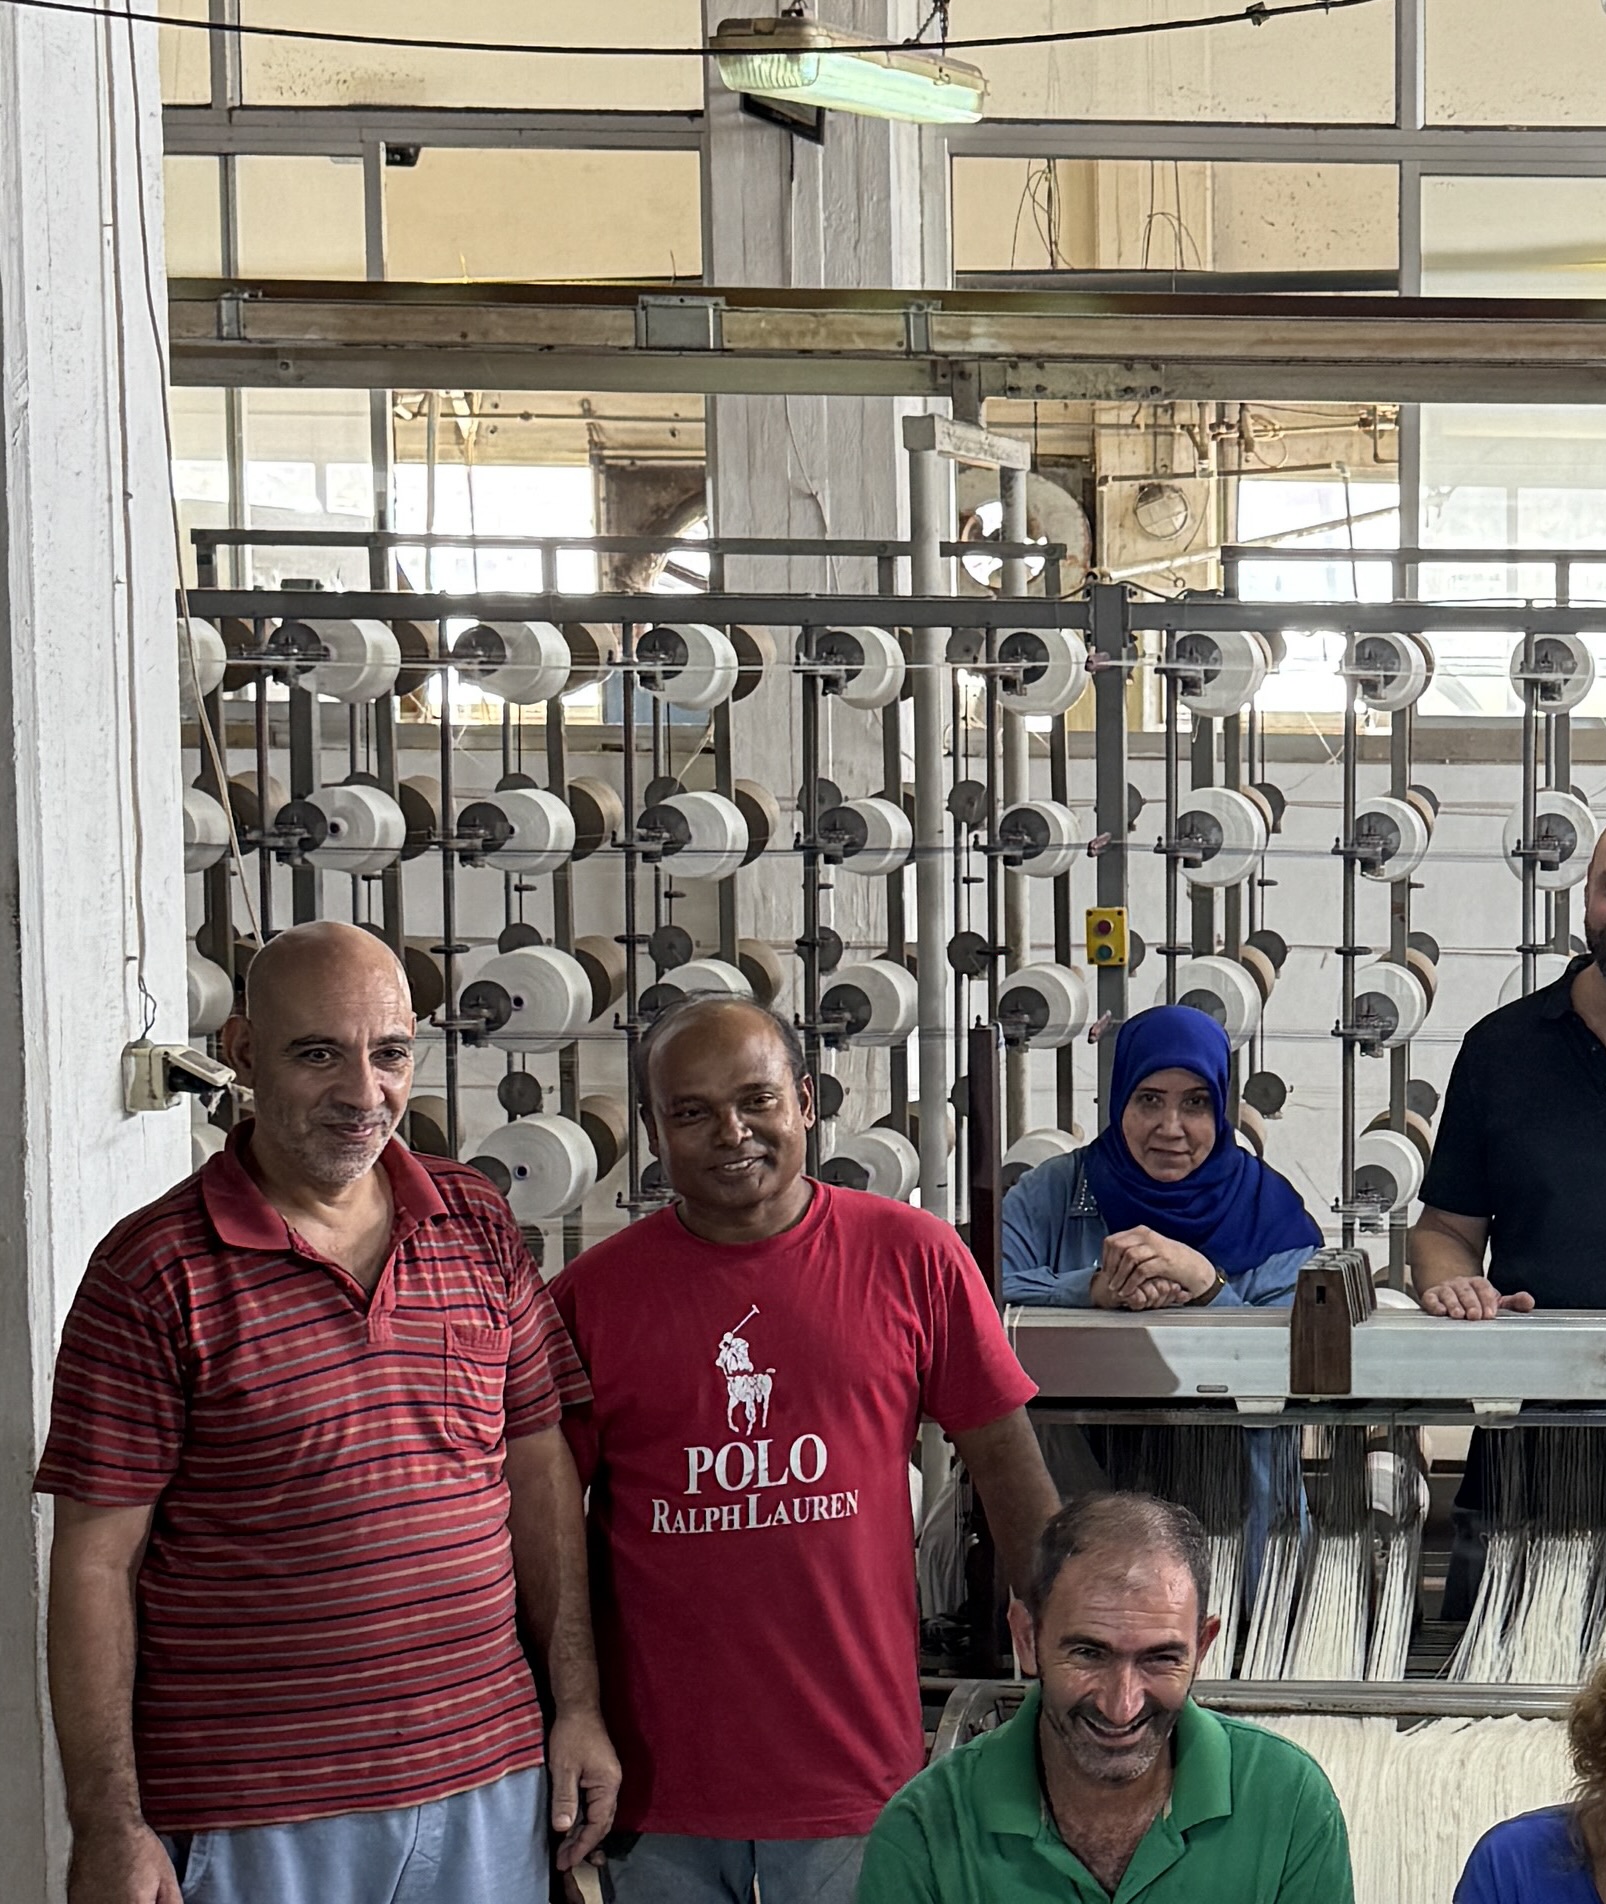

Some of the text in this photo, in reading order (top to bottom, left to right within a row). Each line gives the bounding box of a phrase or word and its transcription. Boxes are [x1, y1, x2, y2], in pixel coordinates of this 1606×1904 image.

[683, 1433, 828, 1495] POLO
[651, 1489, 859, 1534] RALPH LAUREN
